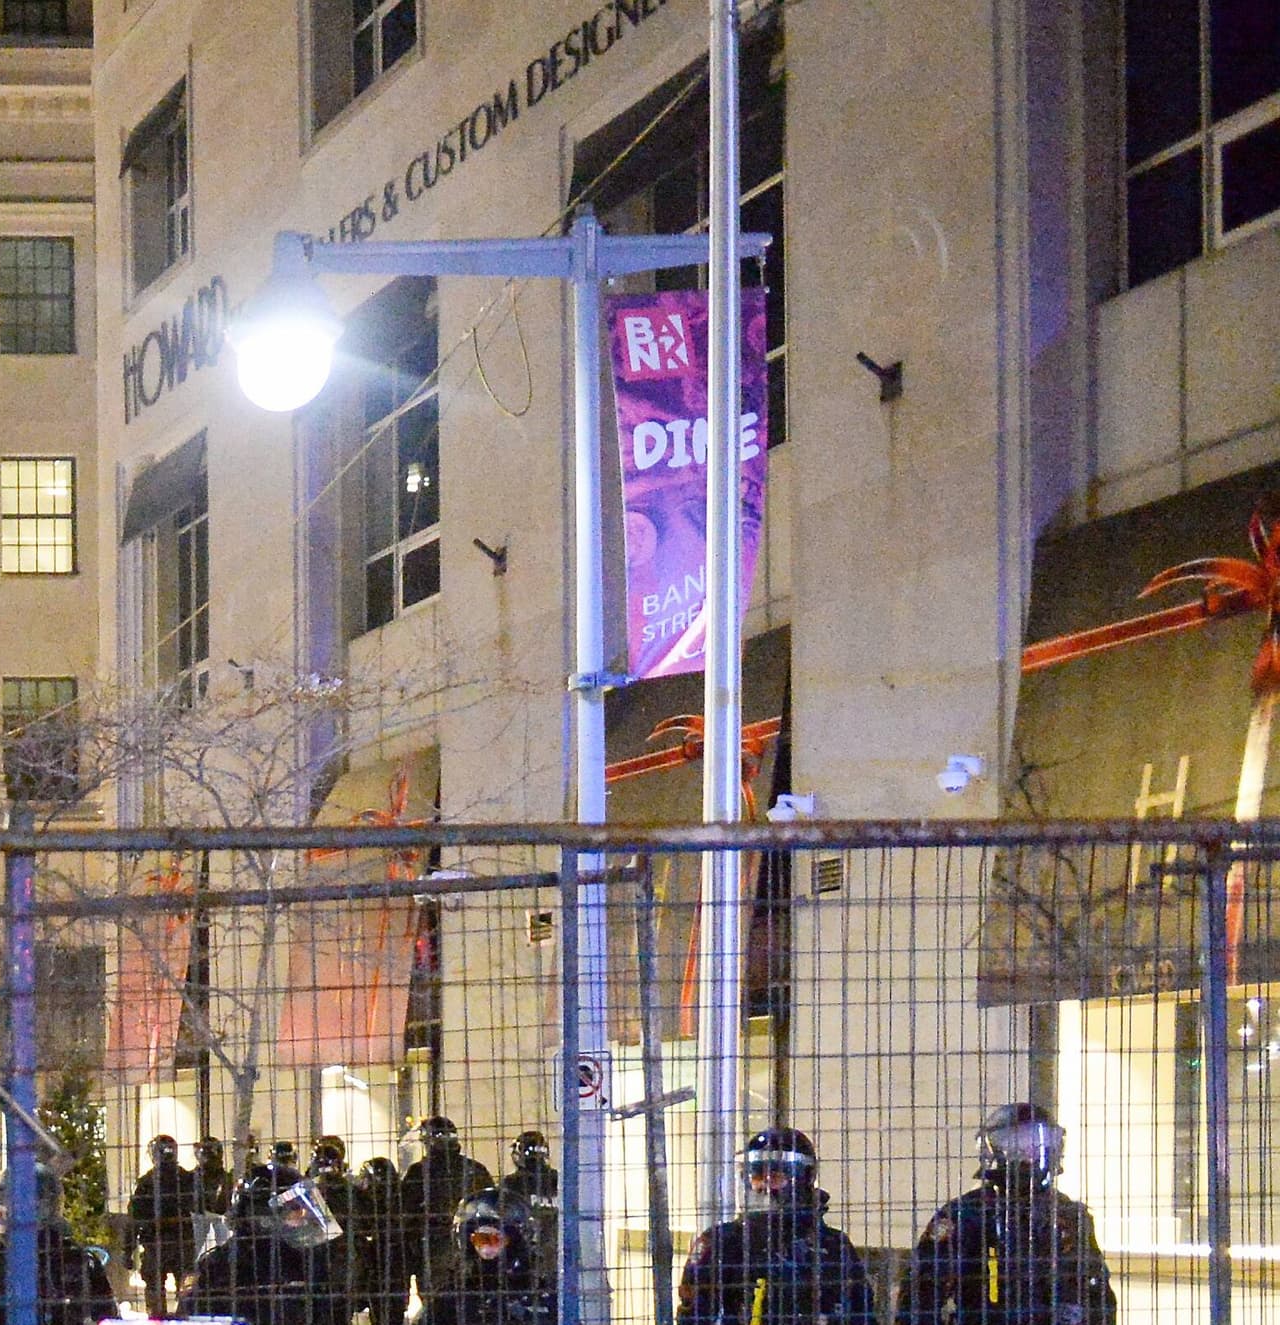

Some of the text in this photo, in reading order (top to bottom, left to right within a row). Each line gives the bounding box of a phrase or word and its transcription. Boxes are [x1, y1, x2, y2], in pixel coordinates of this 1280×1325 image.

[405, 79, 519, 201] CUSTOM
[526, 0, 667, 107] DESIGN
[643, 564, 705, 616] BAN
[642, 602, 702, 642] STRE
